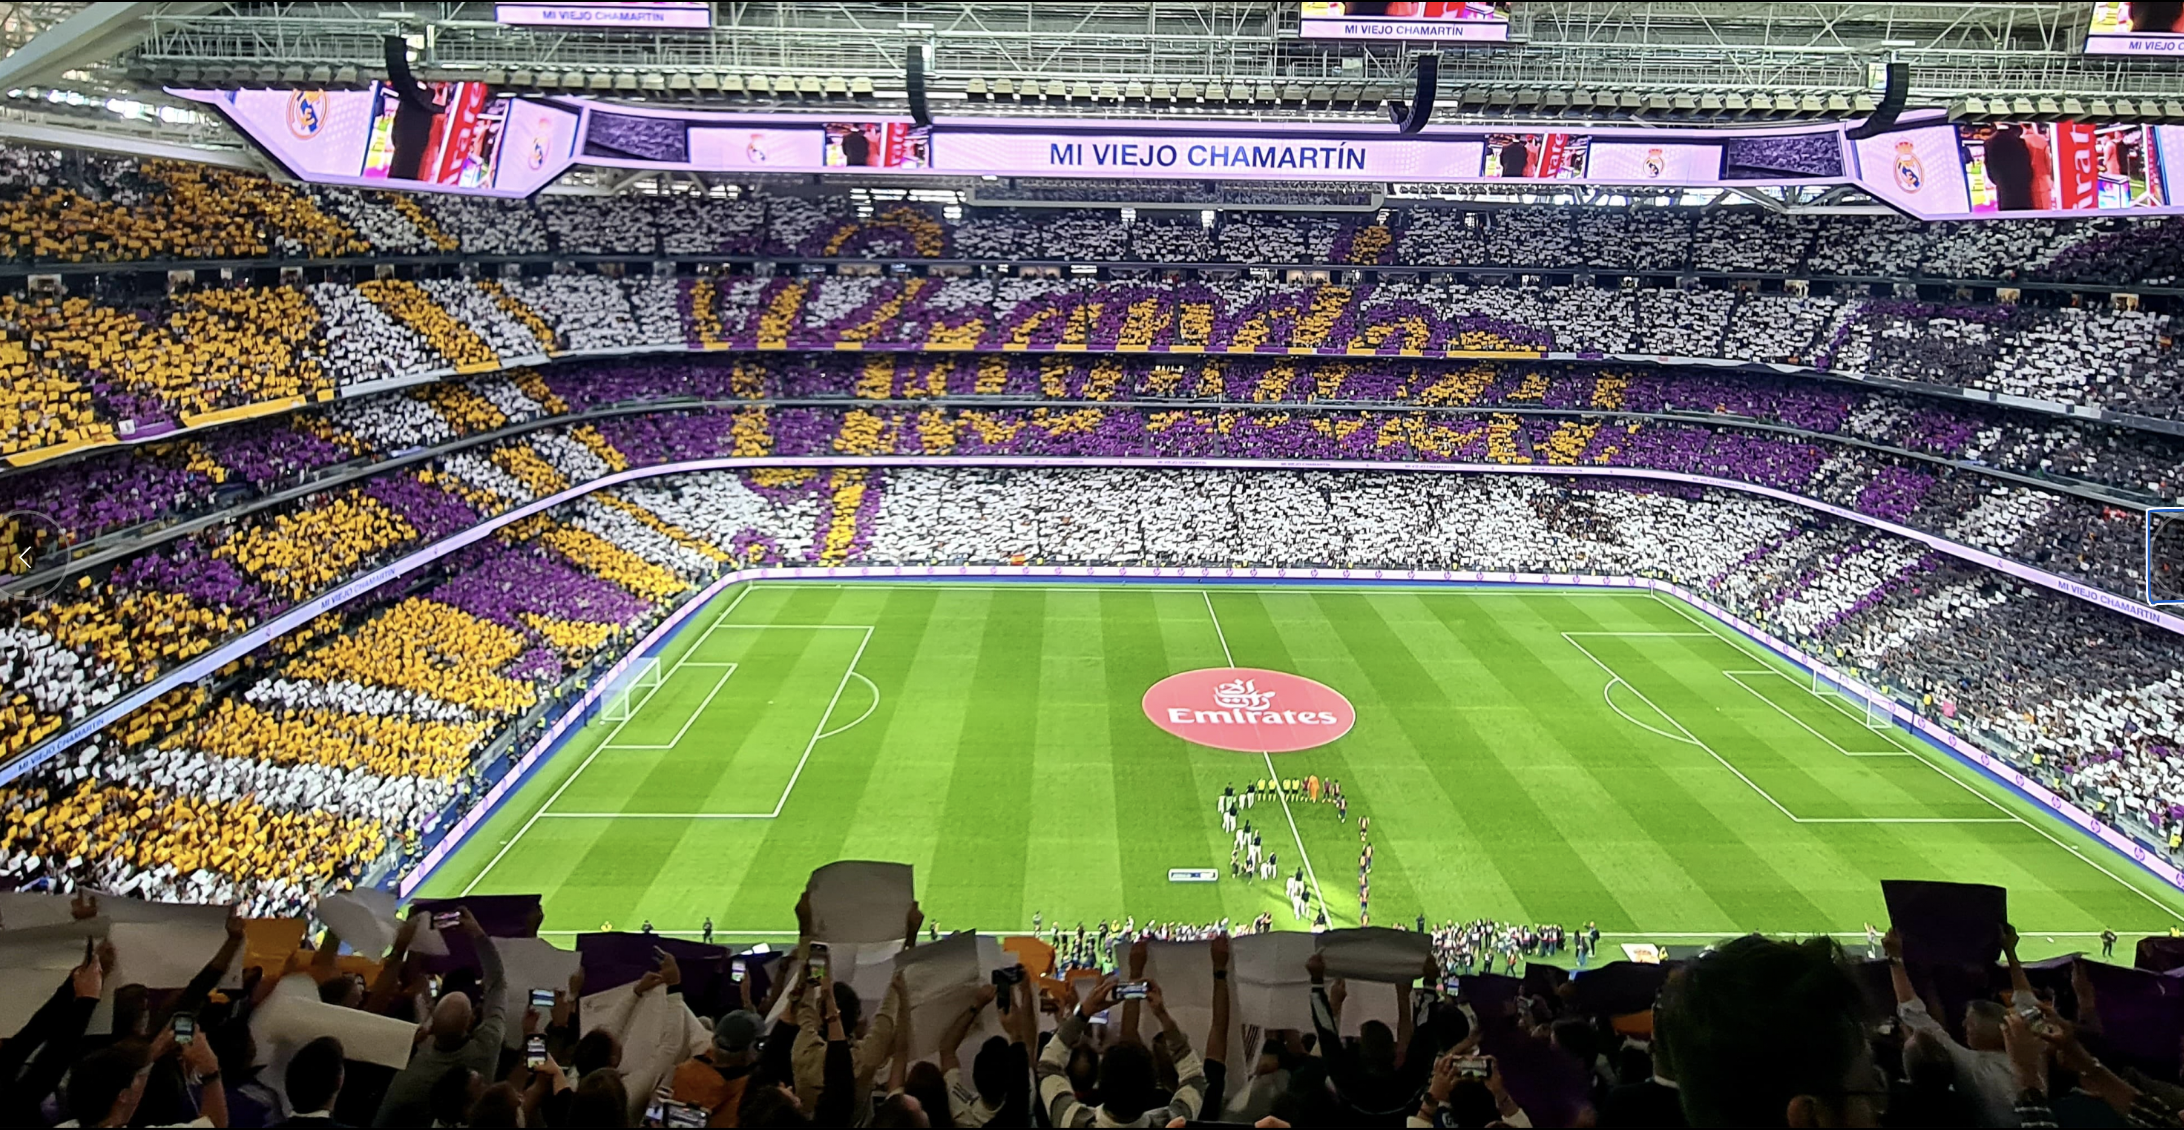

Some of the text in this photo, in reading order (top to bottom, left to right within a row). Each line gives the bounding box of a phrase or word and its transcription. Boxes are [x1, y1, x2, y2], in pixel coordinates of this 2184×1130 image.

[543, 11, 556, 19] MI
[559, 11, 592, 20] VIEJO
[1345, 24, 1463, 36] MI VIEJO CHAMARTÍN
[2129, 41, 2142, 50] MI
[2145, 42, 2176, 51] VIEJO
[1050, 141, 1366, 170] MI VIEJO CHAMARTÍN
[2058, 580, 2069, 590] MI
[2071, 585, 2098, 600] VIEJO
[1167, 708, 1337, 725] Emirates
